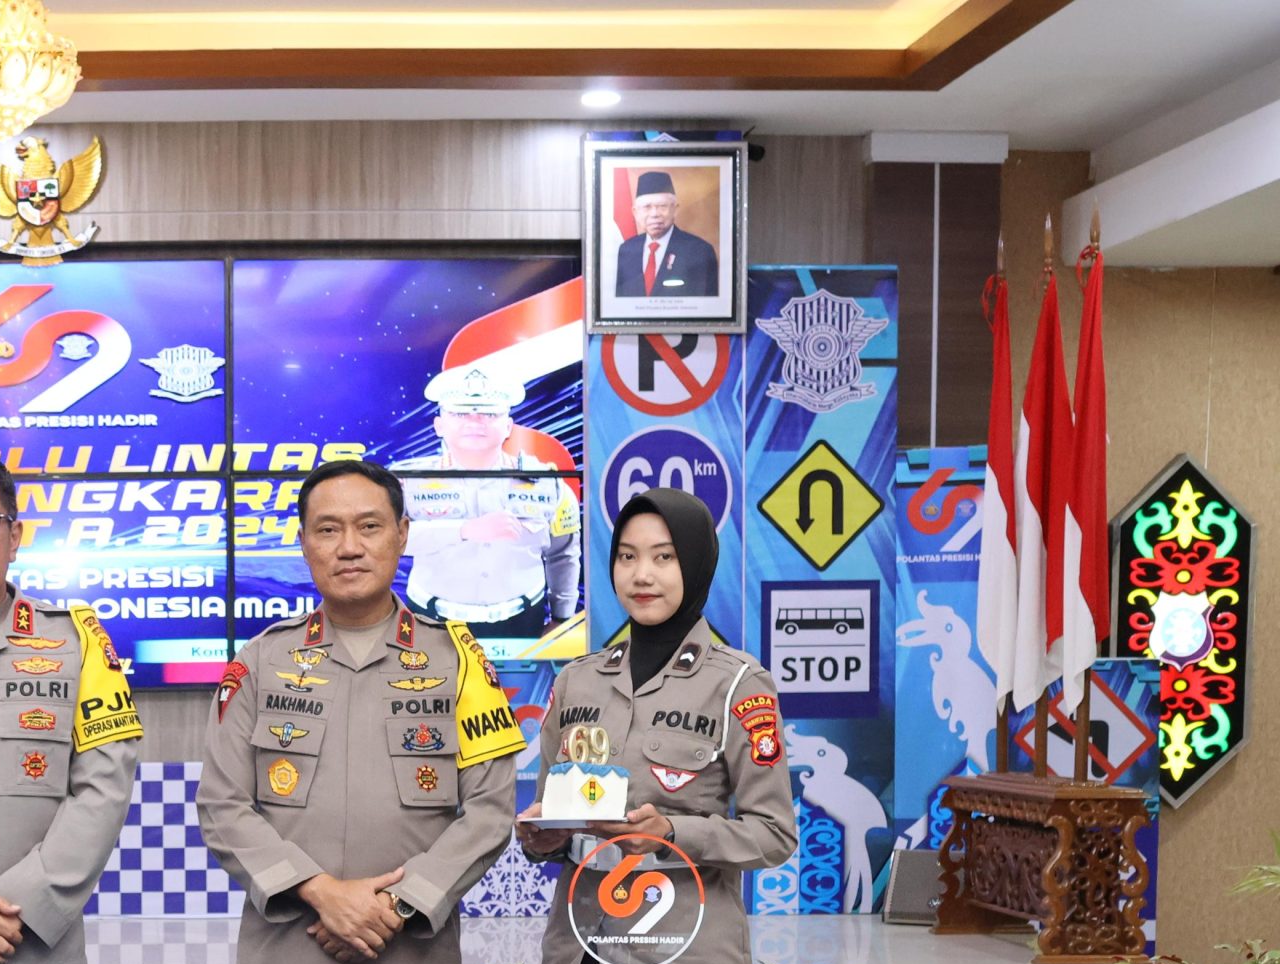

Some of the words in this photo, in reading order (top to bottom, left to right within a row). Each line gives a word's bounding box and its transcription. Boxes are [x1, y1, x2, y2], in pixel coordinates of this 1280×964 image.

[24, 414, 95, 428] PRESISI
[97, 413, 159, 427] HADIR
[108, 442, 367, 474] LINTAS
[694, 459, 717, 476] km
[507, 493, 551, 503] POLRI
[142, 515, 299, 546] 2024
[79, 566, 215, 591] PRESISI
[780, 655, 864, 682] STOP
[5, 680, 69, 699] POLRI
[265, 694, 324, 716] RAKHMAD
[391, 698, 451, 715] POLRI
[736, 696, 773, 715] POLDA
[652, 709, 717, 738] POLRI
[568, 725, 610, 765] 69
[587, 935, 629, 944] POLANTAS
[629, 935, 659, 944] PRESISI
[660, 936, 685, 944] HADIR
